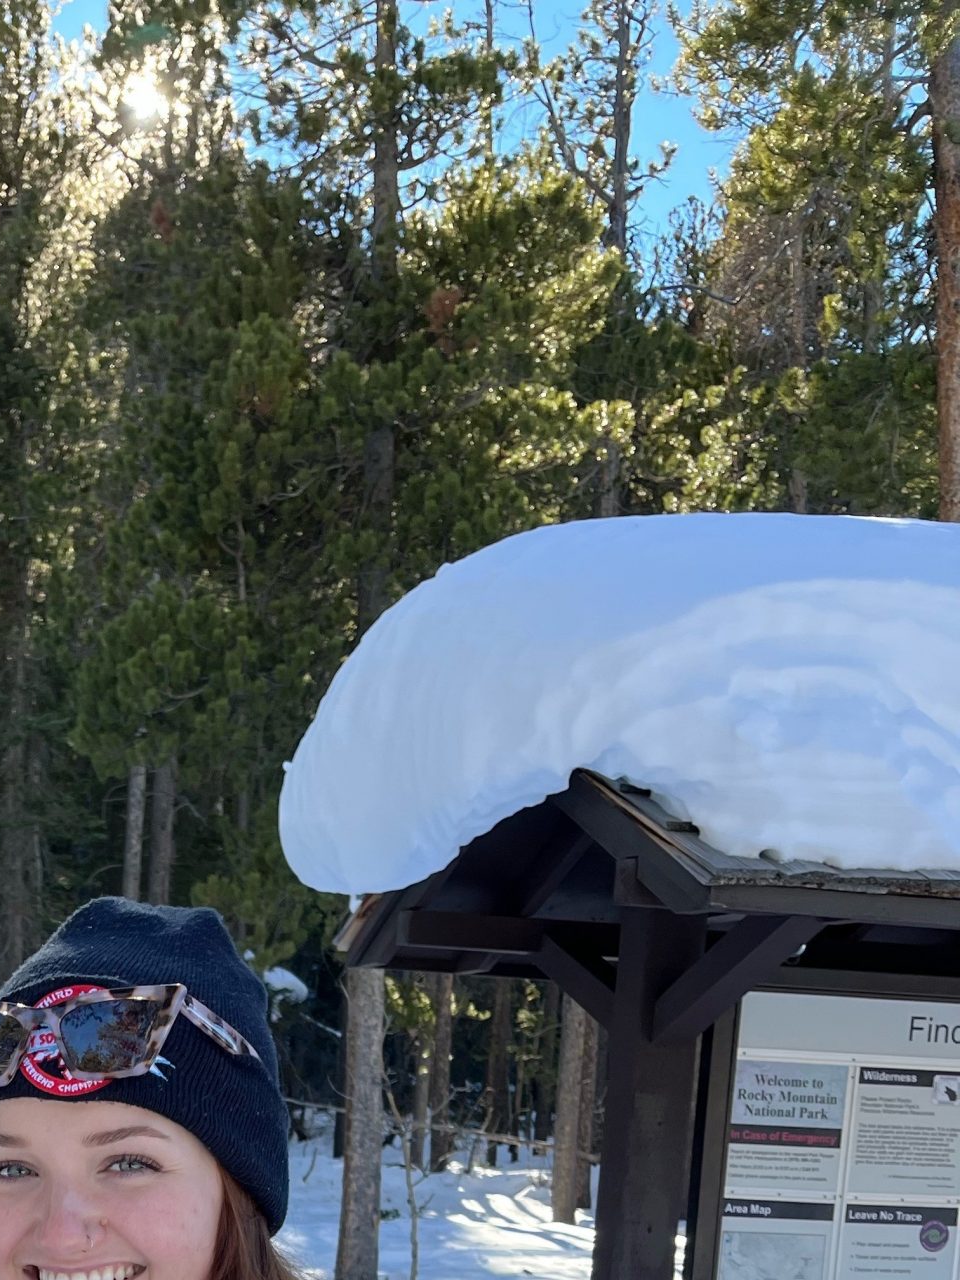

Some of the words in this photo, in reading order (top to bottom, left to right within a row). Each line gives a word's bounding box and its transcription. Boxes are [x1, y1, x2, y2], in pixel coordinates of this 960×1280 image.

[23, 1057, 55, 1089] WEEKEND
[863, 1071, 917, 1082] Wilderness
[755, 1074, 809, 1088] Welcome
[812, 1079, 824, 1088] to
[738, 1088, 774, 1104] Rocky
[779, 1091, 837, 1104] Mountain
[744, 1104, 795, 1117] National
[799, 1107, 828, 1119] Park
[730, 1130, 739, 1139] In
[743, 1130, 767, 1140] Case
[769, 1132, 779, 1140] of
[782, 1132, 836, 1145] Emergency
[725, 1203, 748, 1214] Area
[750, 1205, 771, 1216] Map
[849, 1210, 877, 1220] Leave
[880, 1210, 894, 1221] No
[896, 1211, 922, 1222] Trace
